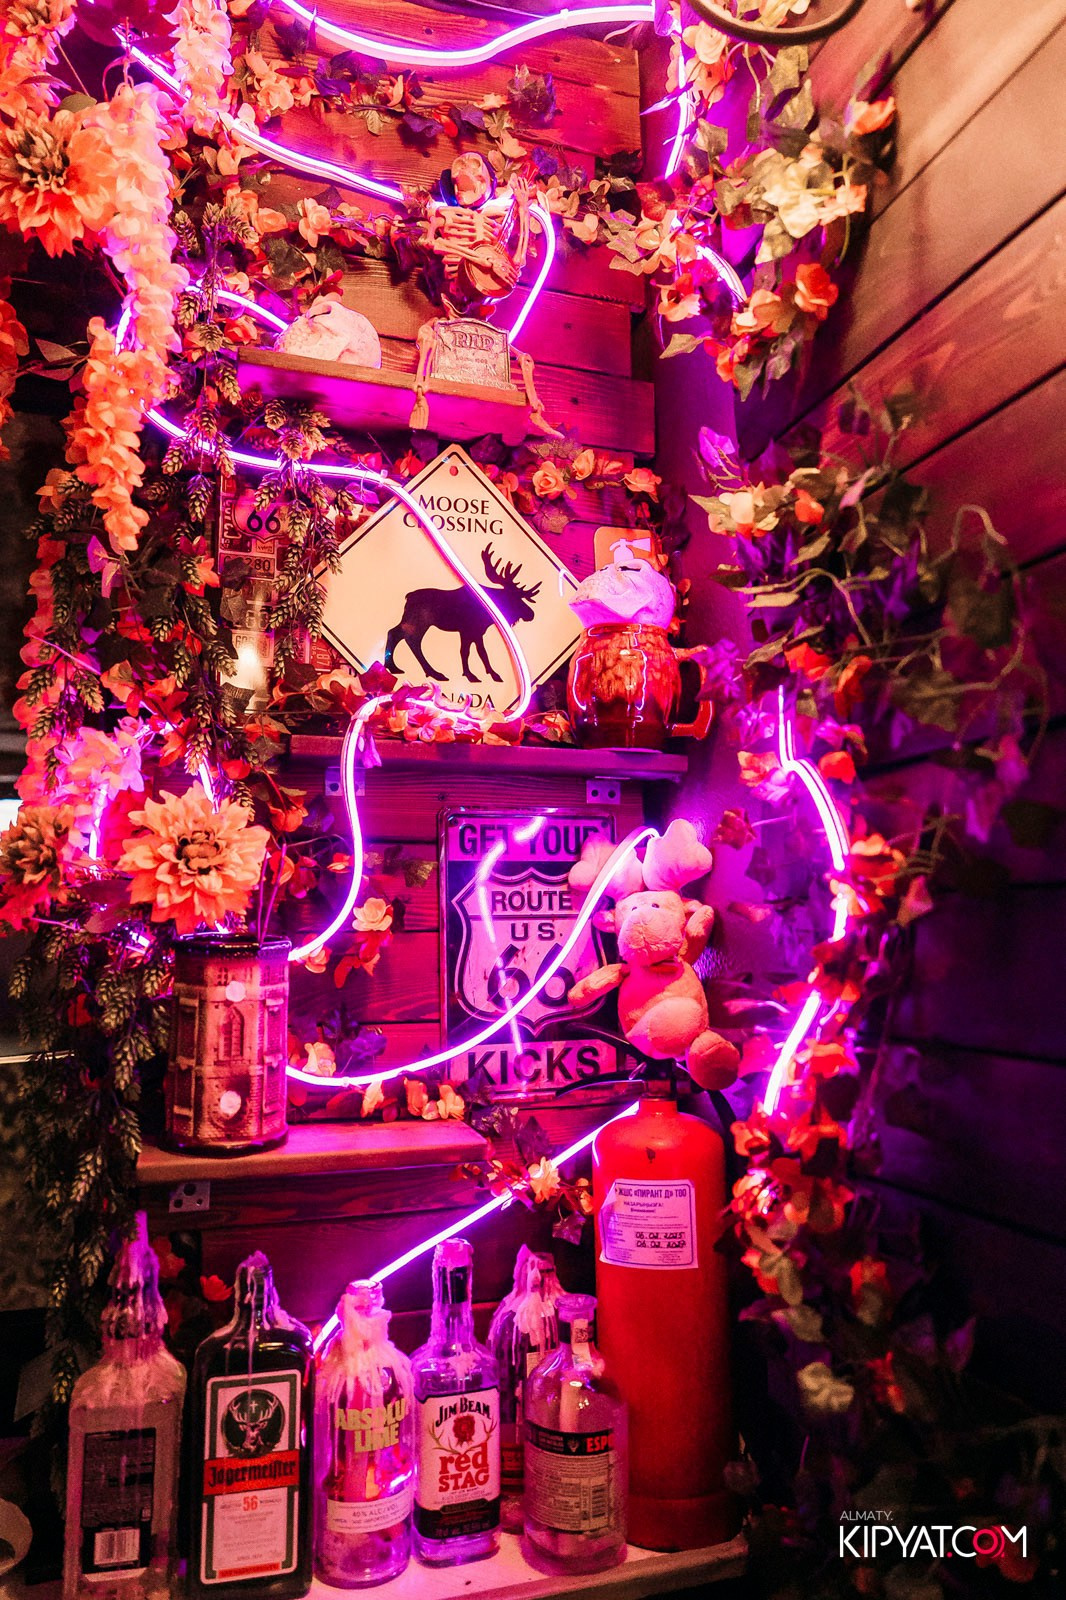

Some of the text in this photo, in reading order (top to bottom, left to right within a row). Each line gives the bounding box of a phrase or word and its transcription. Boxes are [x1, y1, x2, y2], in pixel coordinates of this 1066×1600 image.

[418, 494, 490, 515] MOOSE
[247, 508, 281, 534] 66
[442, 692, 495, 709] NADA
[459, 824, 509, 857] GET
[491, 890, 573, 913] ROUTE
[487, 943, 576, 1011] 66
[468, 1045, 600, 1085] KICKS
[435, 1396, 491, 1428] JIM BEAM
[439, 1442, 490, 1475] red
[438, 1468, 490, 1493] STAG
[242, 1495, 259, 1512] 56
